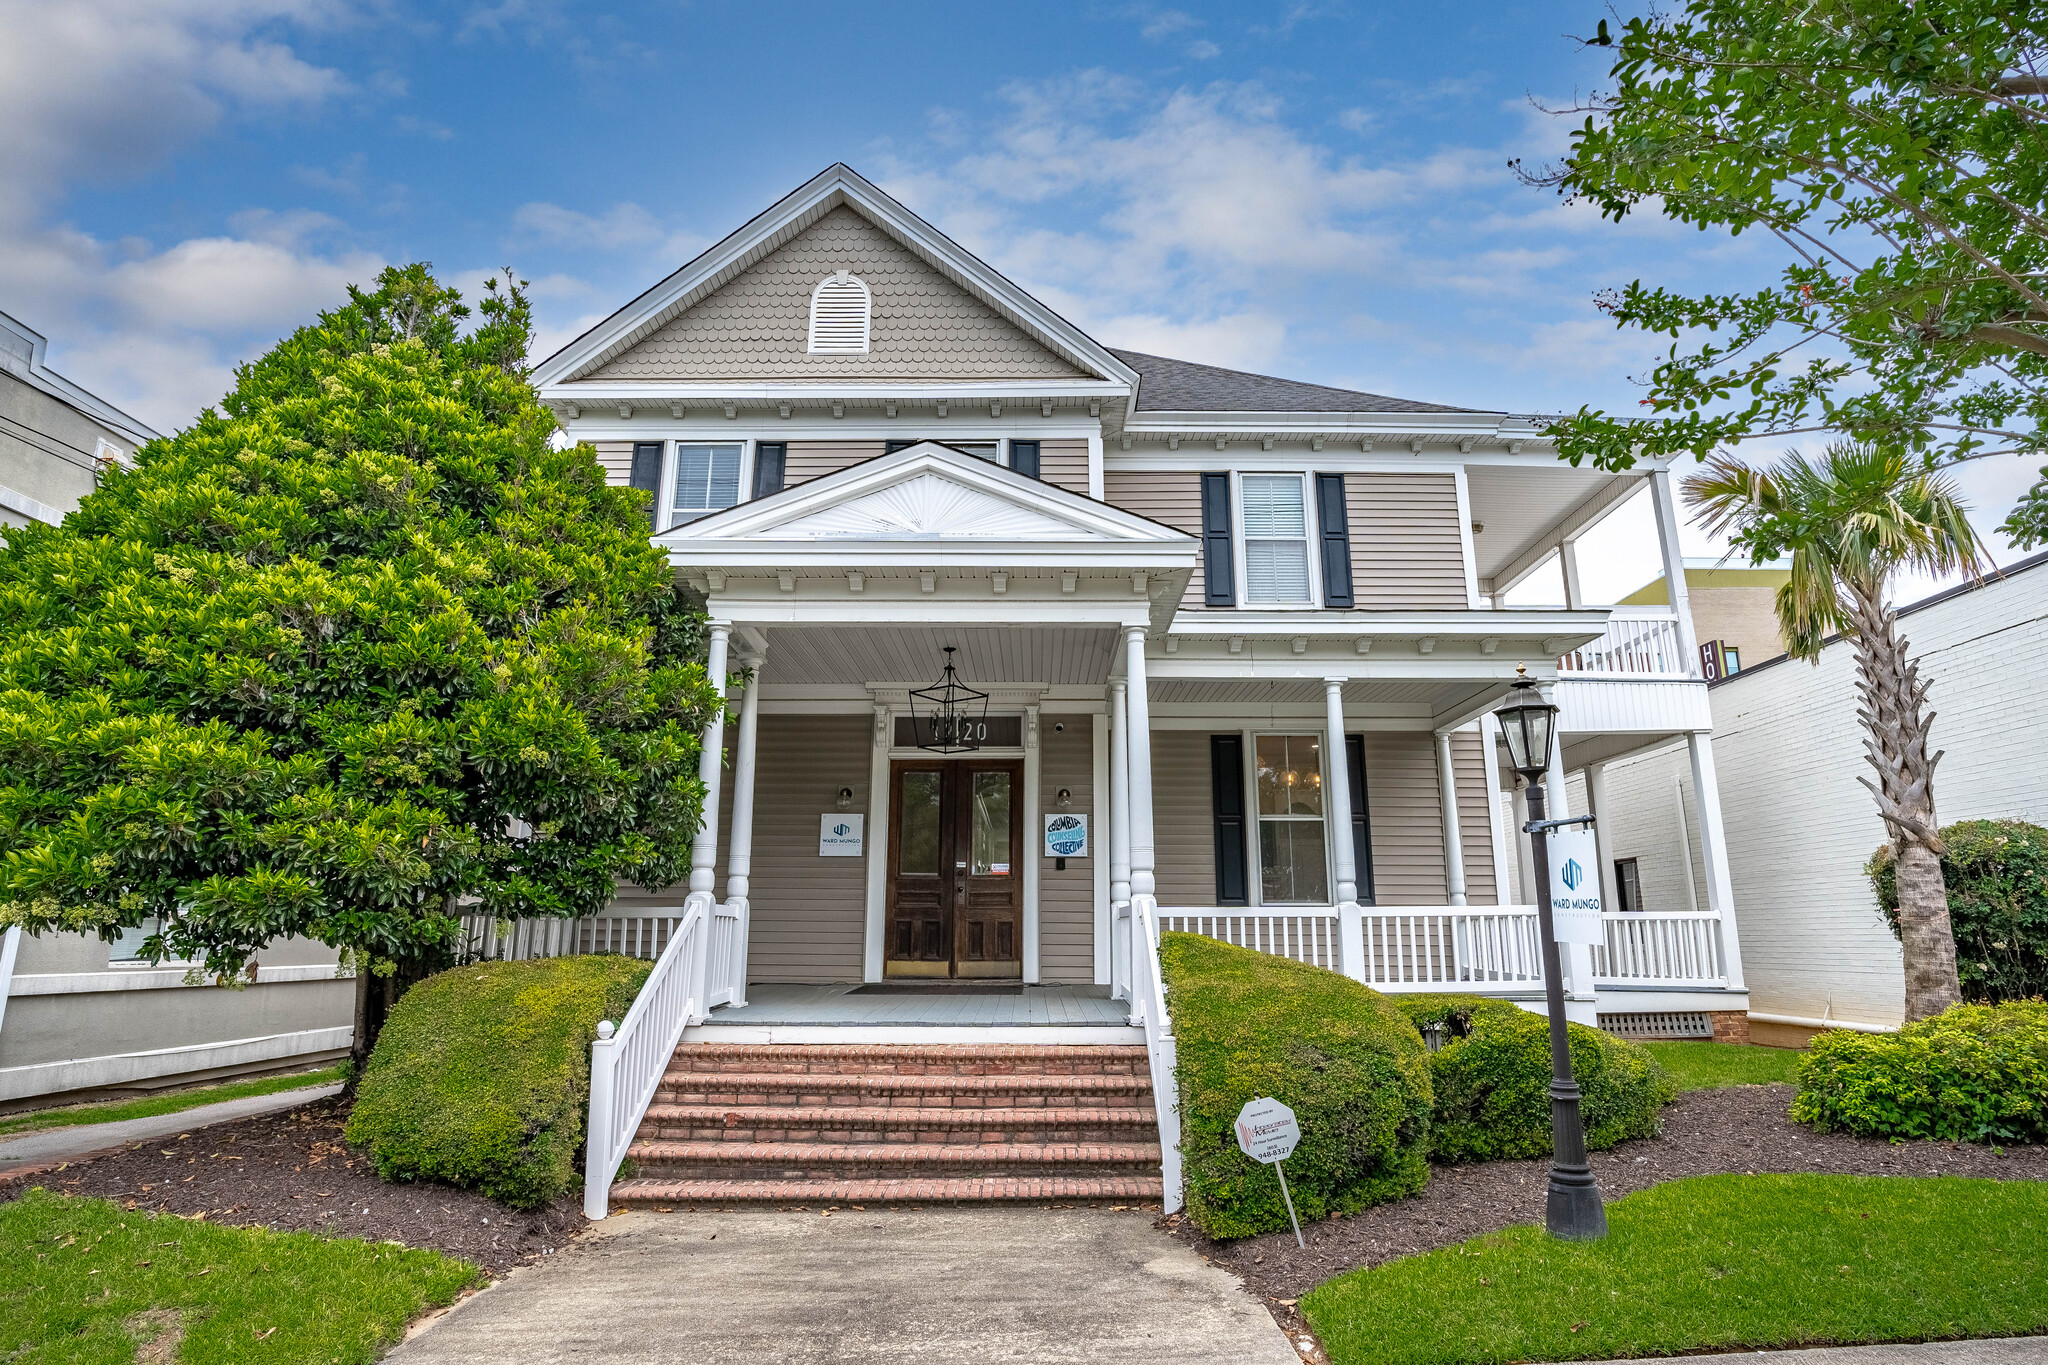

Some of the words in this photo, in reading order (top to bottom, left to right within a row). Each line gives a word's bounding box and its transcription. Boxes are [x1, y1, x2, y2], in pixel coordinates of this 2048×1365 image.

[1703, 644, 1716, 681] HO
[1047, 816, 1081, 832] COLUMBIA
[1047, 825, 1086, 843] COUNSELING
[1051, 839, 1084, 855] COLLECTIVE
[1552, 898, 1570, 909] WARD
[1572, 898, 1600, 910] MUNGO
[1258, 1147, 1290, 1160] 948-8327
